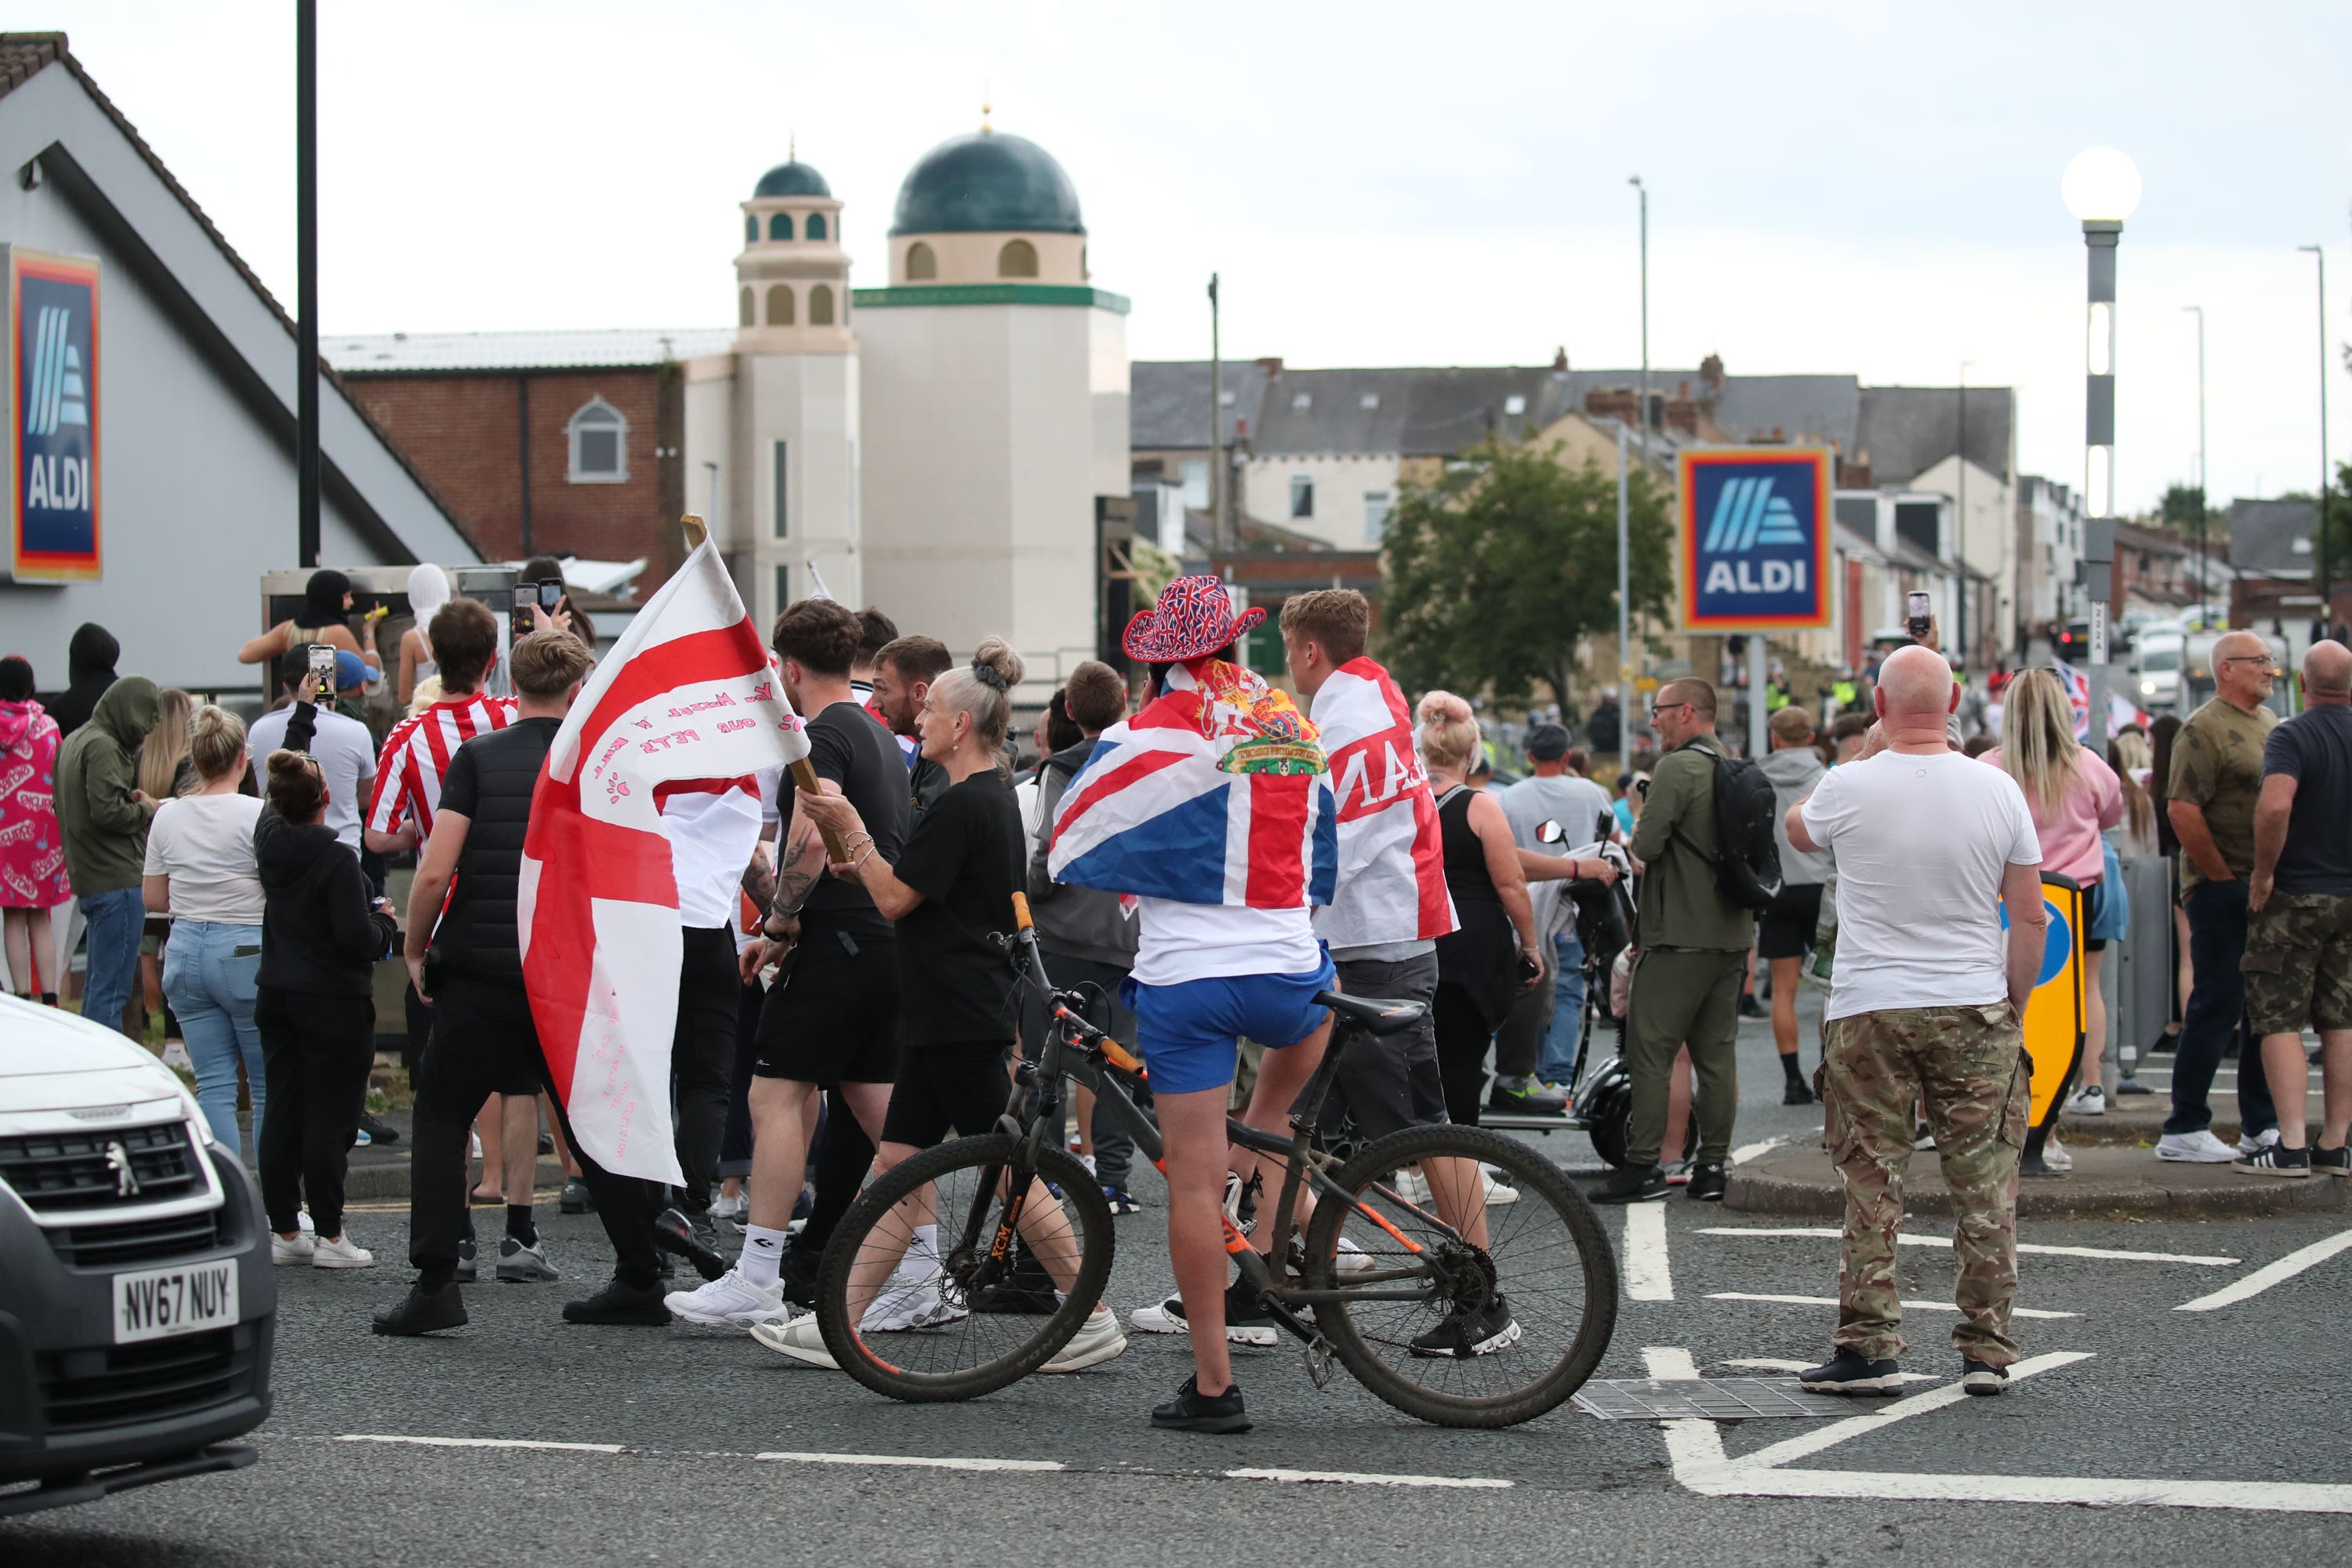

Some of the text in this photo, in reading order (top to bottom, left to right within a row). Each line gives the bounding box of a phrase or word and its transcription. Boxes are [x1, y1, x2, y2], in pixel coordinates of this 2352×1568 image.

[27, 453, 89, 512] ALDI
[1704, 559, 1806, 594] ALDI
[991, 1223, 1012, 1261] XCM
[126, 1267, 228, 1331] NV67 NUY
